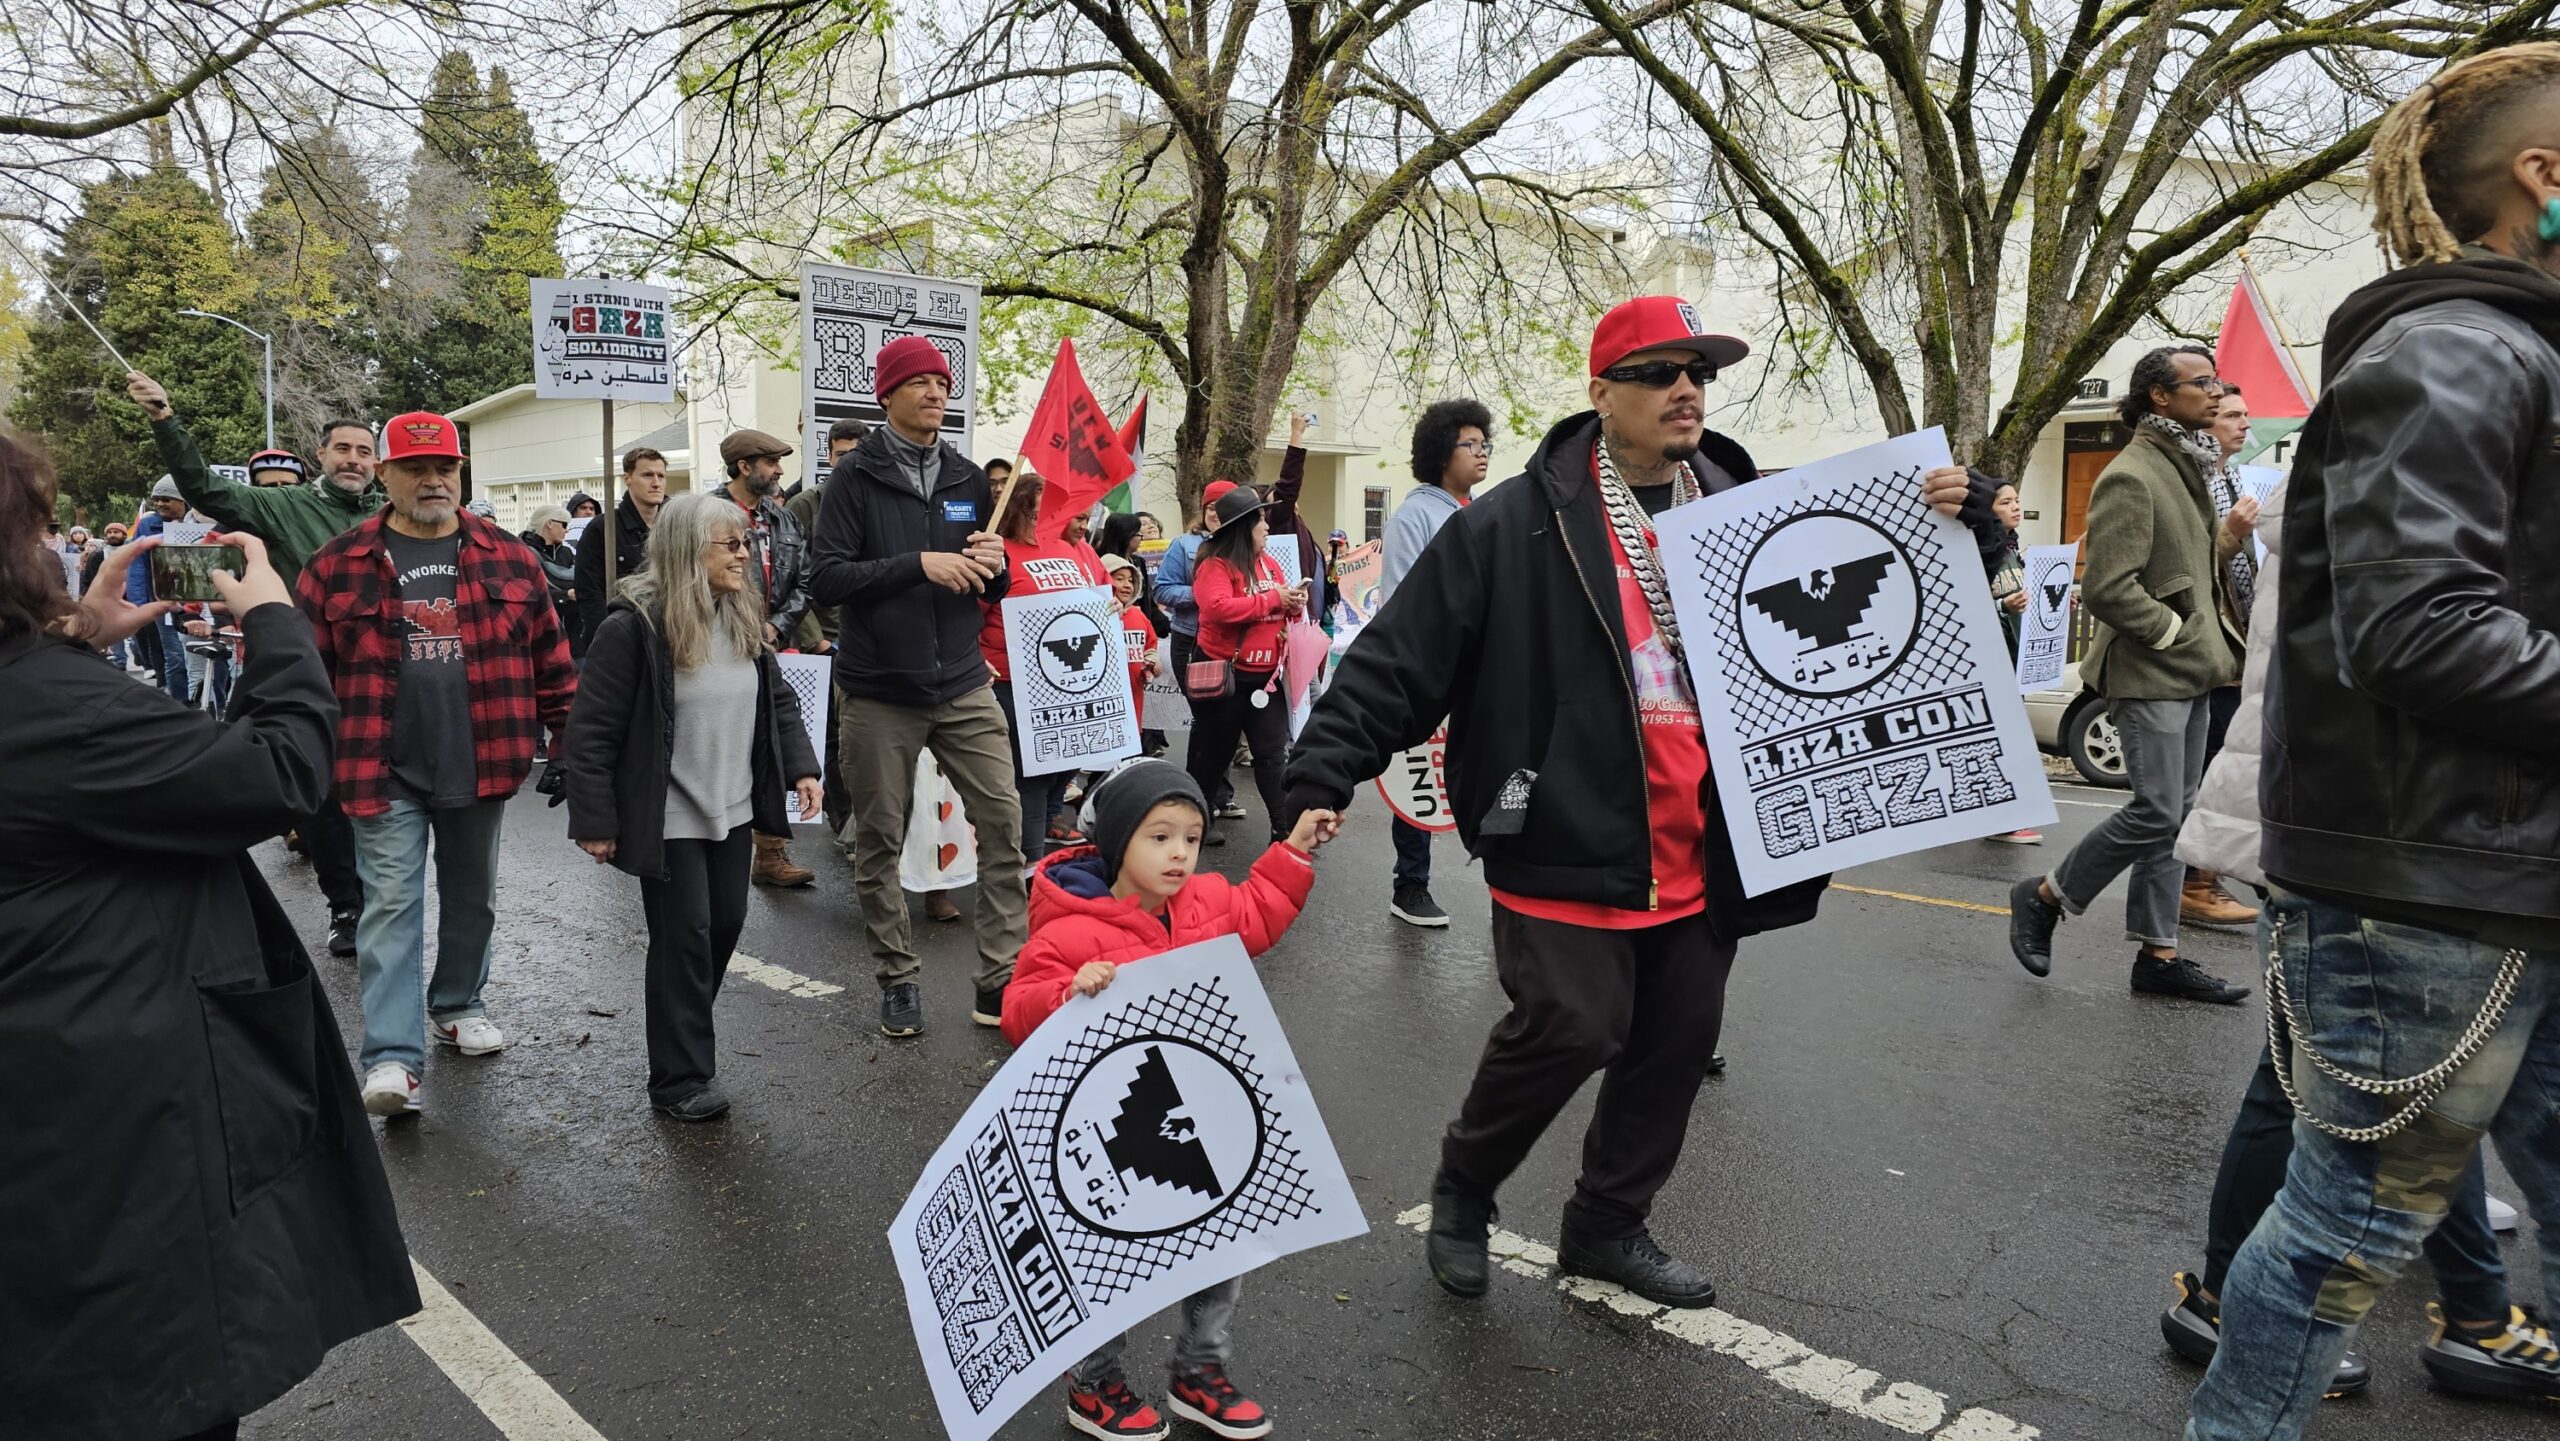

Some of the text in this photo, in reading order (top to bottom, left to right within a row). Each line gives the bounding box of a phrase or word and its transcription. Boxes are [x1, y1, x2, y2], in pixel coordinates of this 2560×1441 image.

[572, 293, 664, 311] I STAND WITH
[812, 275, 967, 321] DESDE EL
[572, 306, 665, 339] GAZA
[567, 341, 665, 361] SOLIDARITY
[562, 363, 668, 388] فلسطين حرة
[2083, 381, 2102, 394] 727
[408, 563, 458, 580] WORKE
[1026, 560, 1080, 574] UNITE
[1246, 650, 1273, 663] JPN
[1791, 635, 1892, 684] غزة حرة
[1031, 697, 1126, 728] RAZA CON
[1034, 717, 1128, 763] GAZA
[1743, 694, 1991, 785] RAZA CON
[1405, 749, 1438, 818] UNI
[1755, 737, 2017, 859] GAZA
[971, 1113, 1083, 1346] RAZA CON
[915, 1163, 1035, 1416] GAZA
